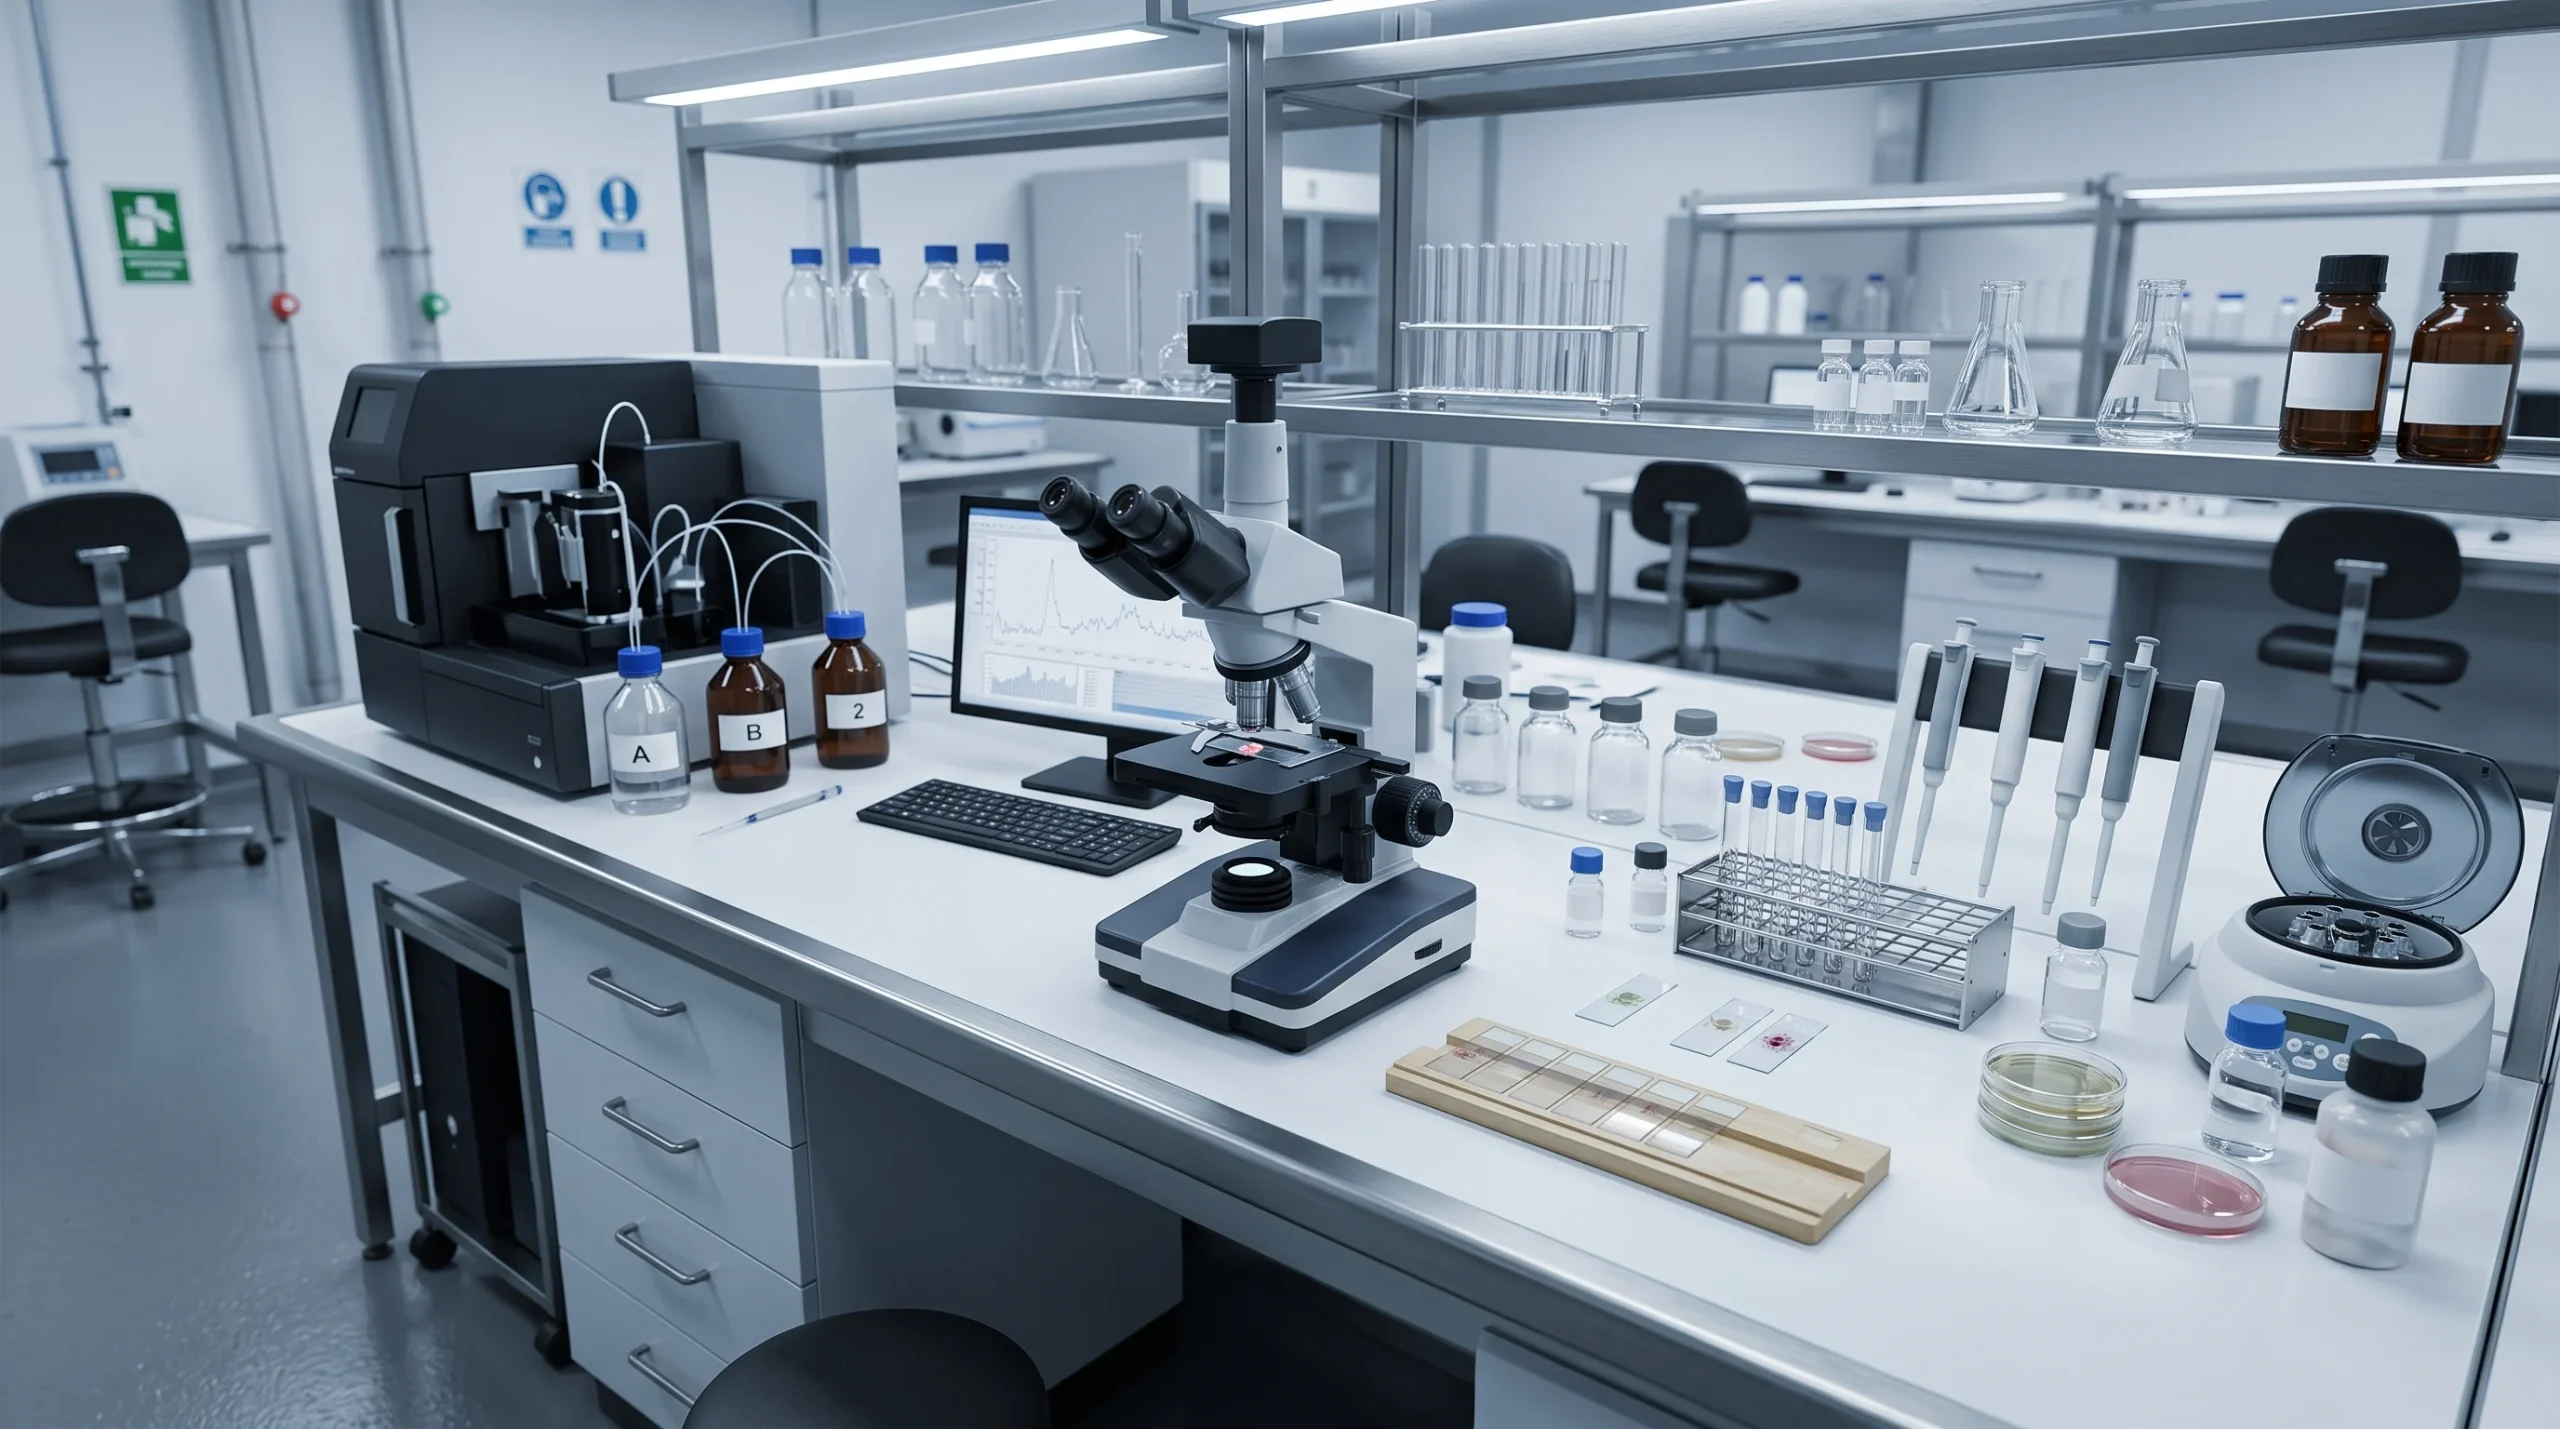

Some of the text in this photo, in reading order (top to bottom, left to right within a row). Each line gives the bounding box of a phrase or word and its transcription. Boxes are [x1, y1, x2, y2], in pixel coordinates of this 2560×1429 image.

[853, 702, 864, 720] 2
[746, 723, 762, 741] B
[632, 745, 651, 764] A
